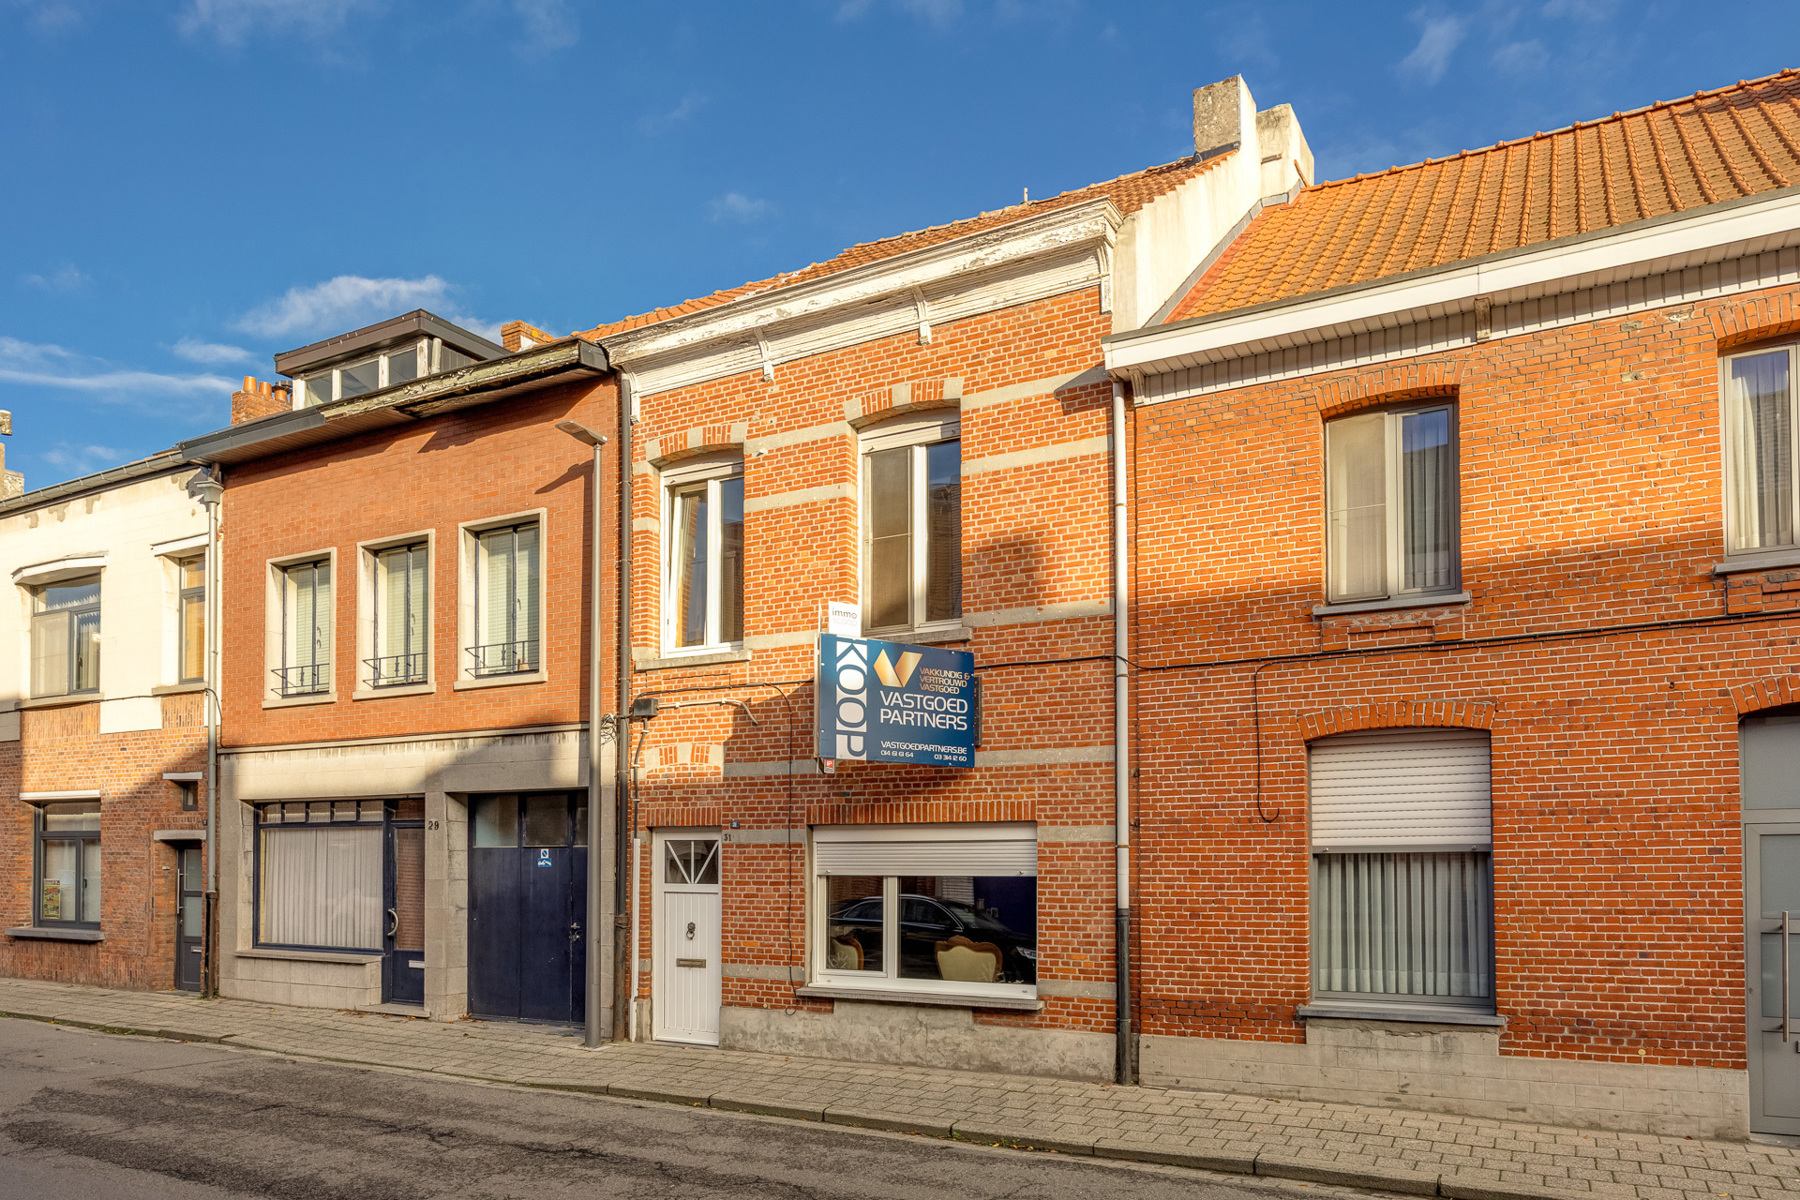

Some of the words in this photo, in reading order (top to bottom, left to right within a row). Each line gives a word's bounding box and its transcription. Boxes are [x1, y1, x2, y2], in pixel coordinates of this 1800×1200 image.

[832, 607, 857, 619] immo
[919, 667, 963, 679] VAKKUNDIG
[964, 672, 970, 680] &
[919, 675, 967, 687] VERTROUWD
[919, 683, 960, 695] VASTGOED
[836, 638, 867, 758] KOOP
[879, 690, 968, 713] VASTGOED
[880, 708, 968, 731] PARTNERS
[880, 740, 967, 755] VASTGOEDPARTNERS.BE
[429, 821, 439, 830] 29
